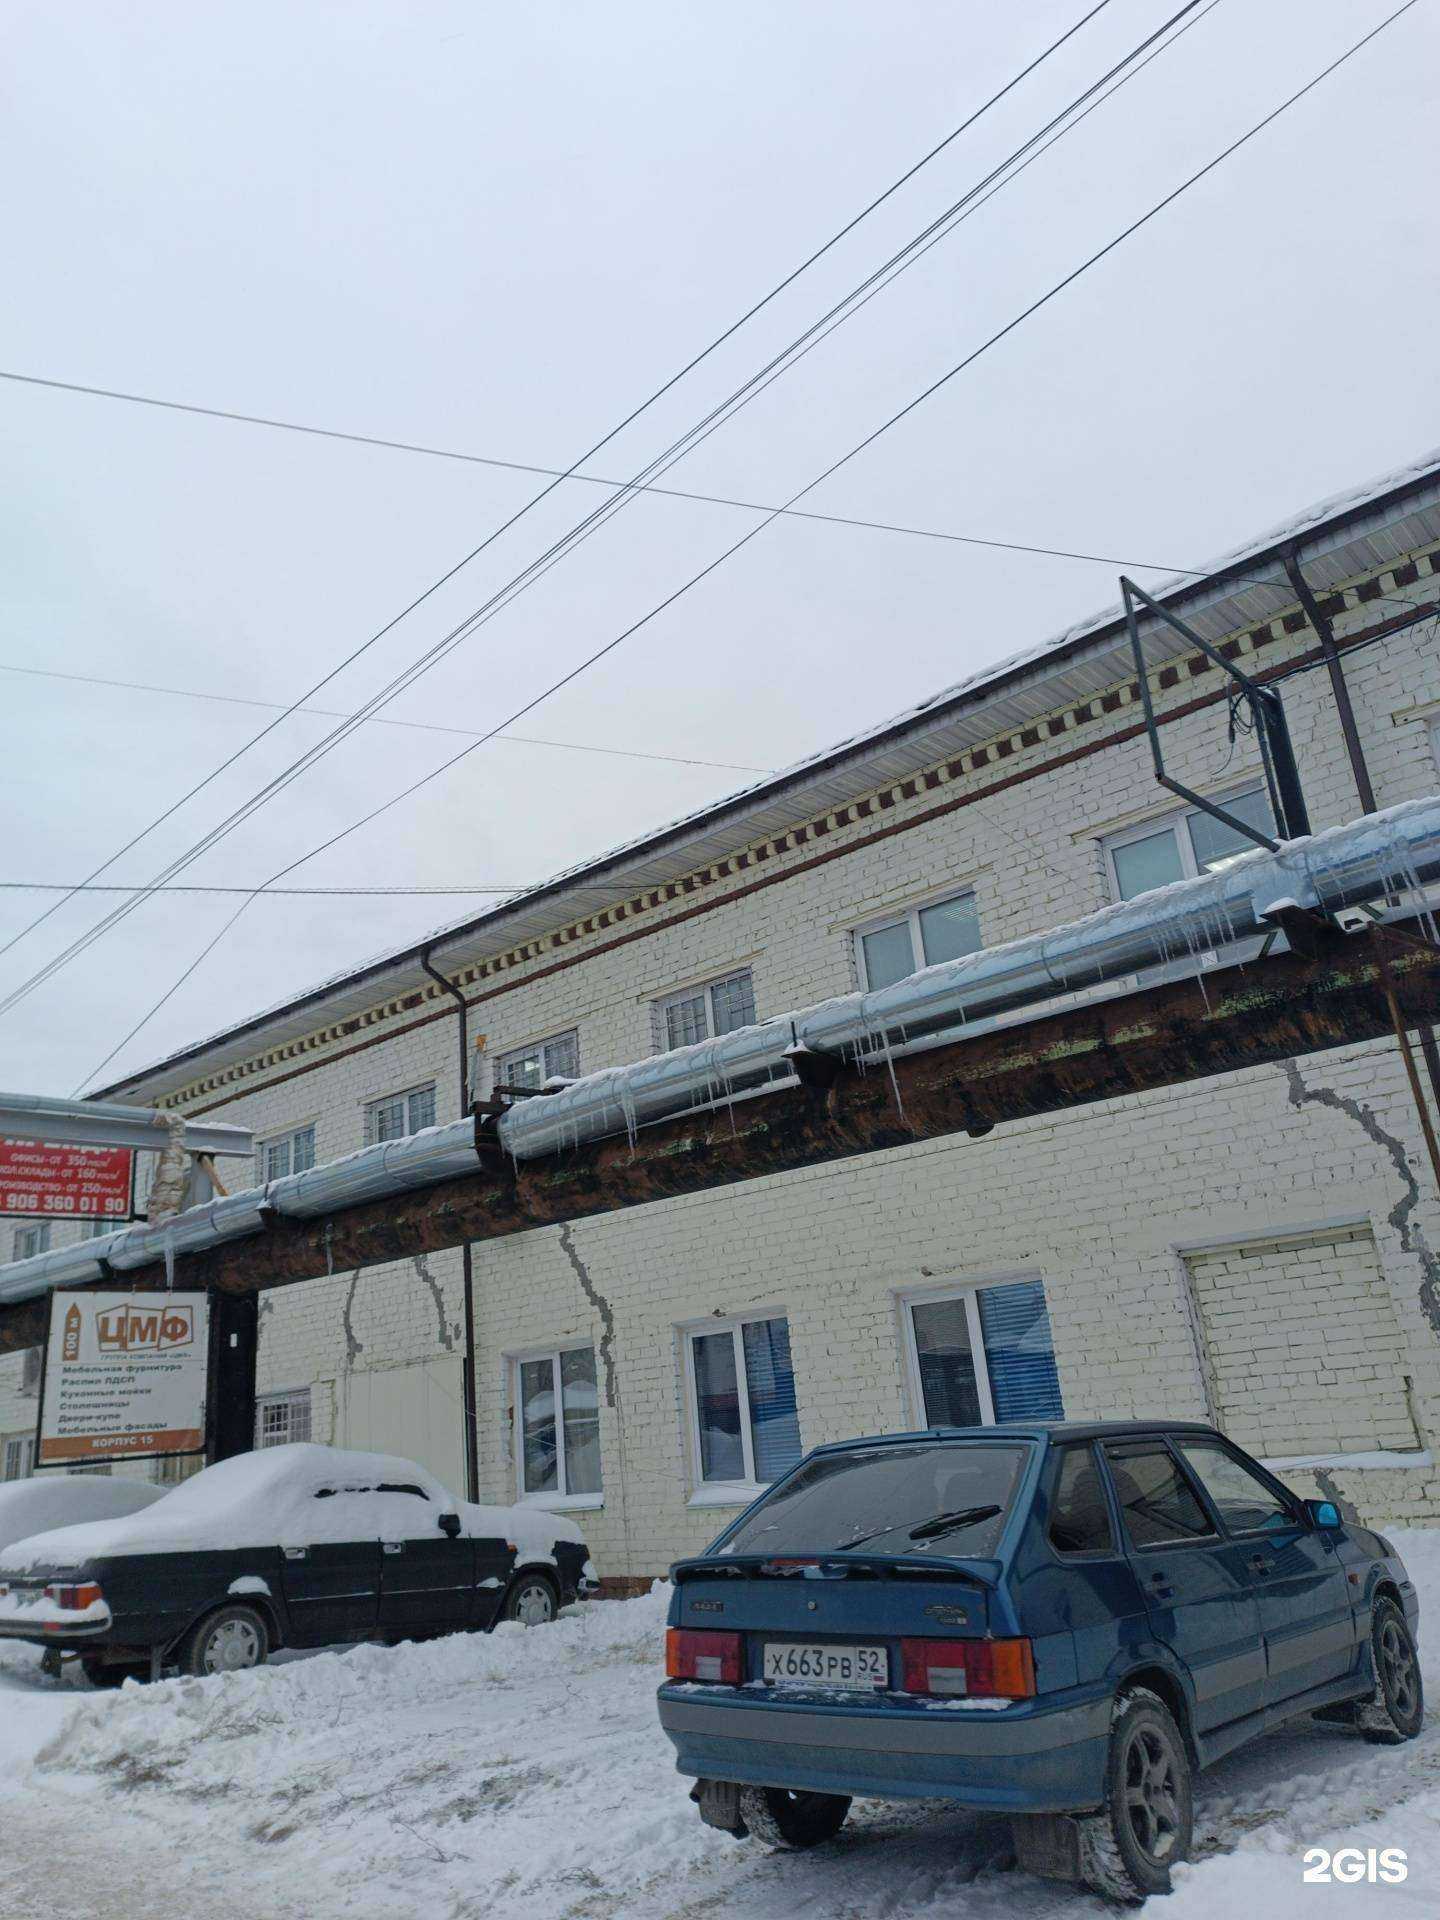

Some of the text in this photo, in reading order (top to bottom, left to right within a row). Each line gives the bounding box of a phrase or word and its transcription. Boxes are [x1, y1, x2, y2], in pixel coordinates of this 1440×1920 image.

[6, 1193, 38, 1210] 906
[43, 1195, 74, 1211] 360
[79, 1197, 98, 1212] 01
[104, 1197, 125, 1213] 90
[101, 1316, 188, 1351] ЦМФ
[61, 1376, 136, 1386] Распил ЛДСП
[59, 1401, 130, 1411] Столешницы
[92, 1435, 153, 1448] КОРПУС 15
[857, 1650, 879, 1673] 52
